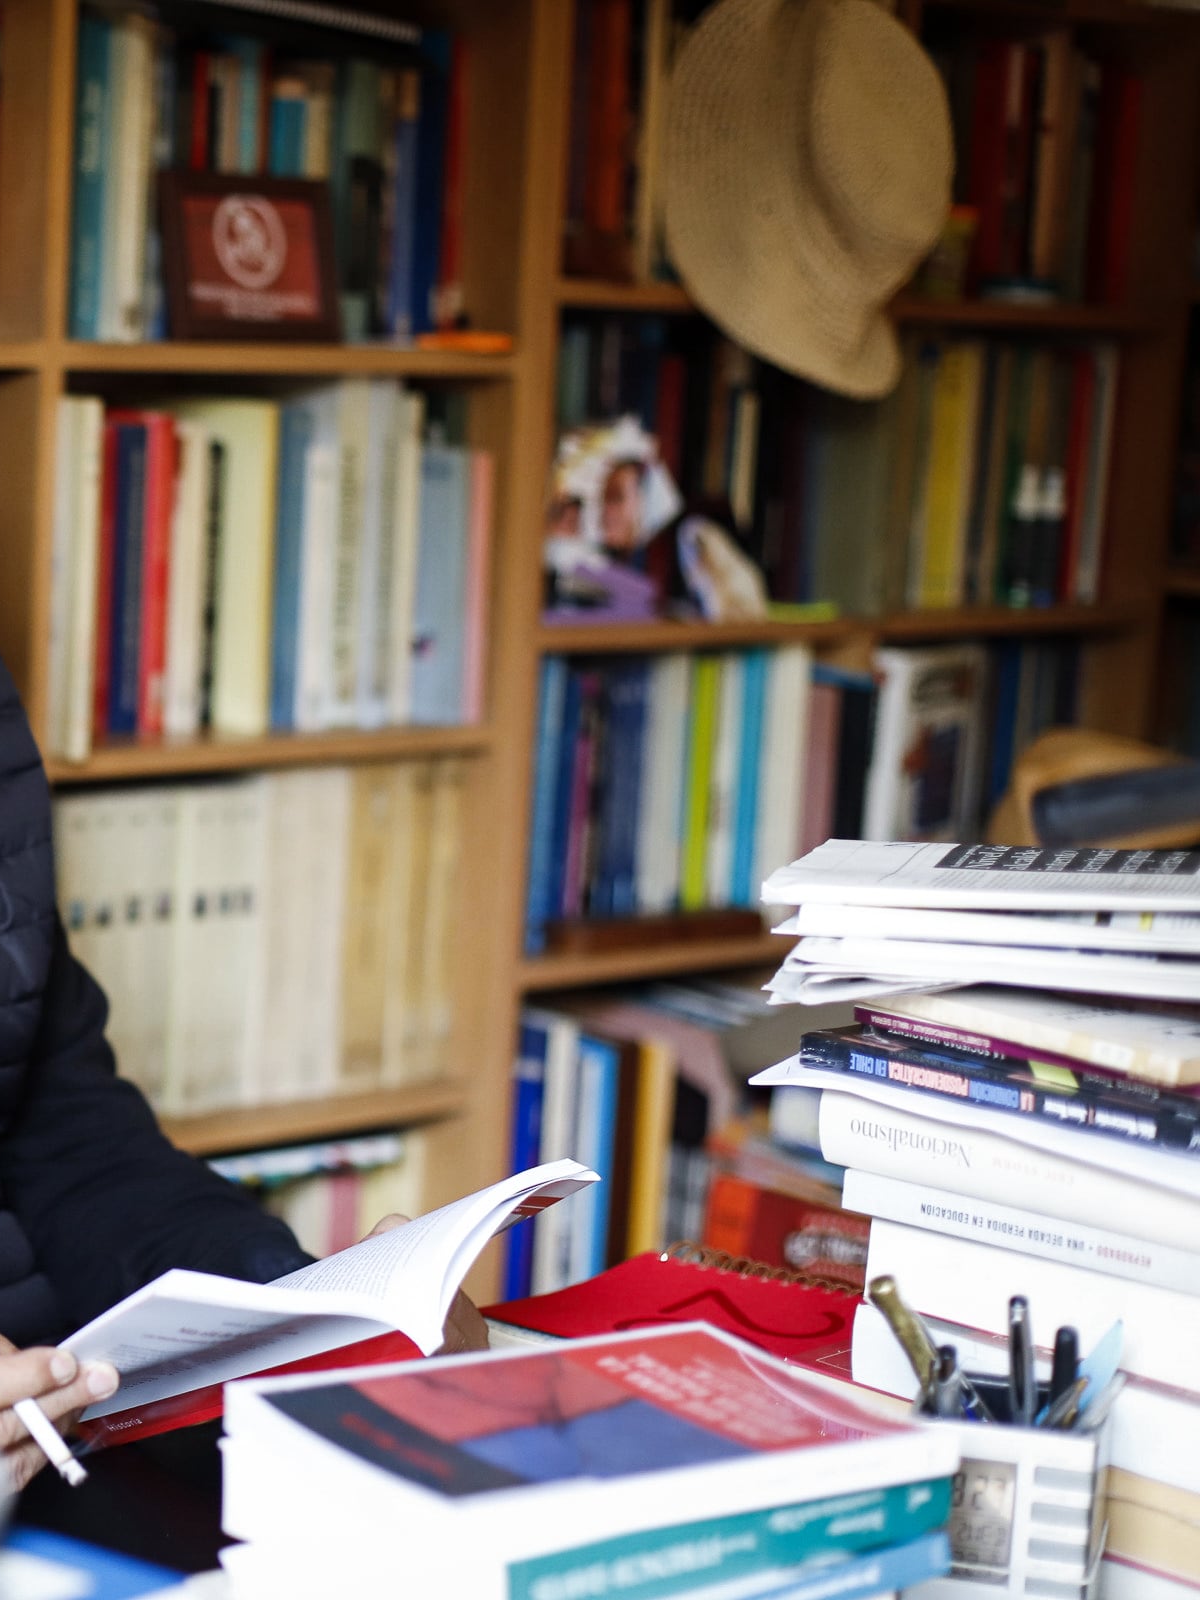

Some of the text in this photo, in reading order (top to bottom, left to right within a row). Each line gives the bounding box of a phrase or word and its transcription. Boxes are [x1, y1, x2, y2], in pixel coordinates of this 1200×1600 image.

[849, 1052, 874, 1075] CHILE
[875, 1057, 888, 1078] EN
[850, 1118, 971, 1168] Nacionalismo
[971, 1216, 985, 1228] EN
[986, 1220, 1025, 1238] PERDIDA
[1067, 1239, 1085, 1251] UNA
[106, 1417, 144, 1432] Historia
